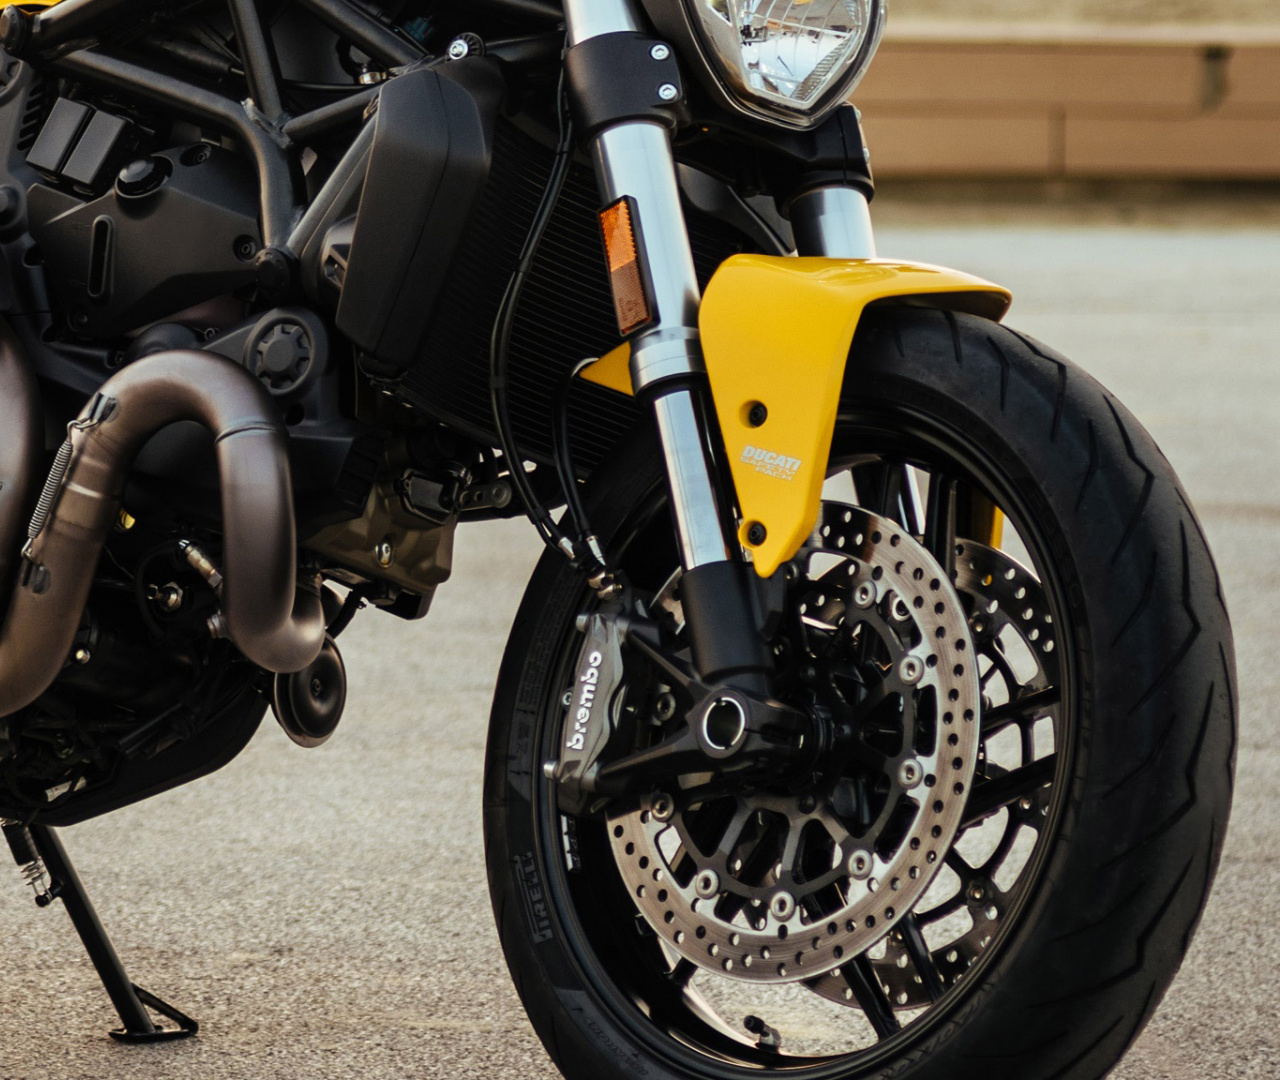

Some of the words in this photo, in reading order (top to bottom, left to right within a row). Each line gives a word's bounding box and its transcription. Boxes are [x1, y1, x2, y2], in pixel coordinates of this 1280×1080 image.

[740, 456, 796, 475] SAFETY
[742, 445, 802, 471] DUCATI
[755, 466, 793, 481] PACK
[566, 650, 603, 750] brembo
